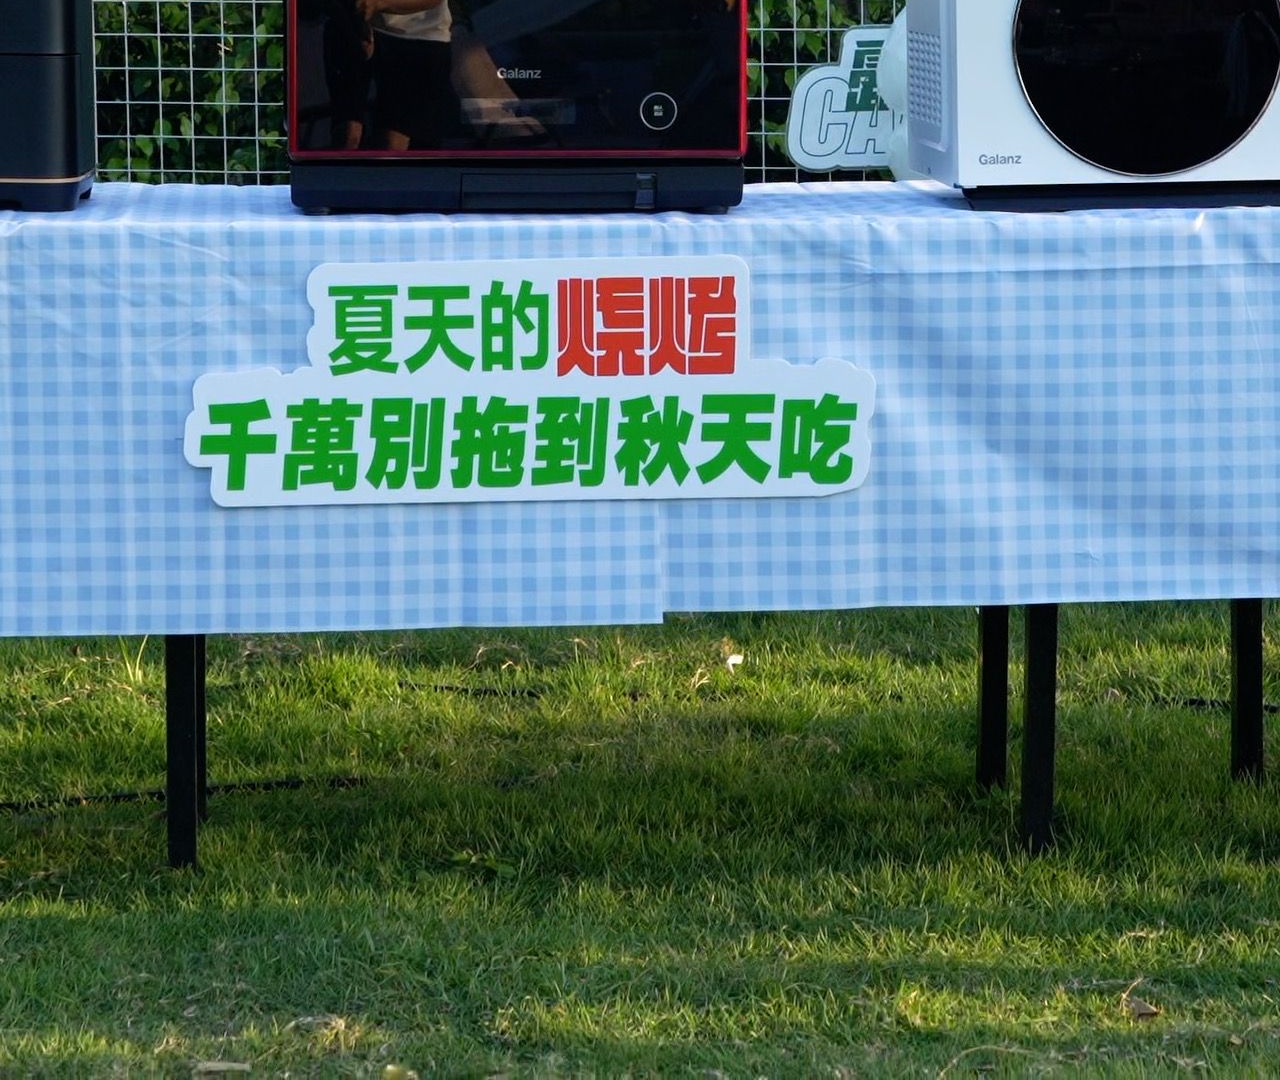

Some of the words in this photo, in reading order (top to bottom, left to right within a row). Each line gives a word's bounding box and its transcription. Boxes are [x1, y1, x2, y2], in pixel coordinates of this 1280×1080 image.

[497, 67, 542, 80] Galanz
[800, 77, 903, 157] CA
[978, 153, 1022, 166] Galanz
[328, 276, 737, 378] 夏天的烧烤
